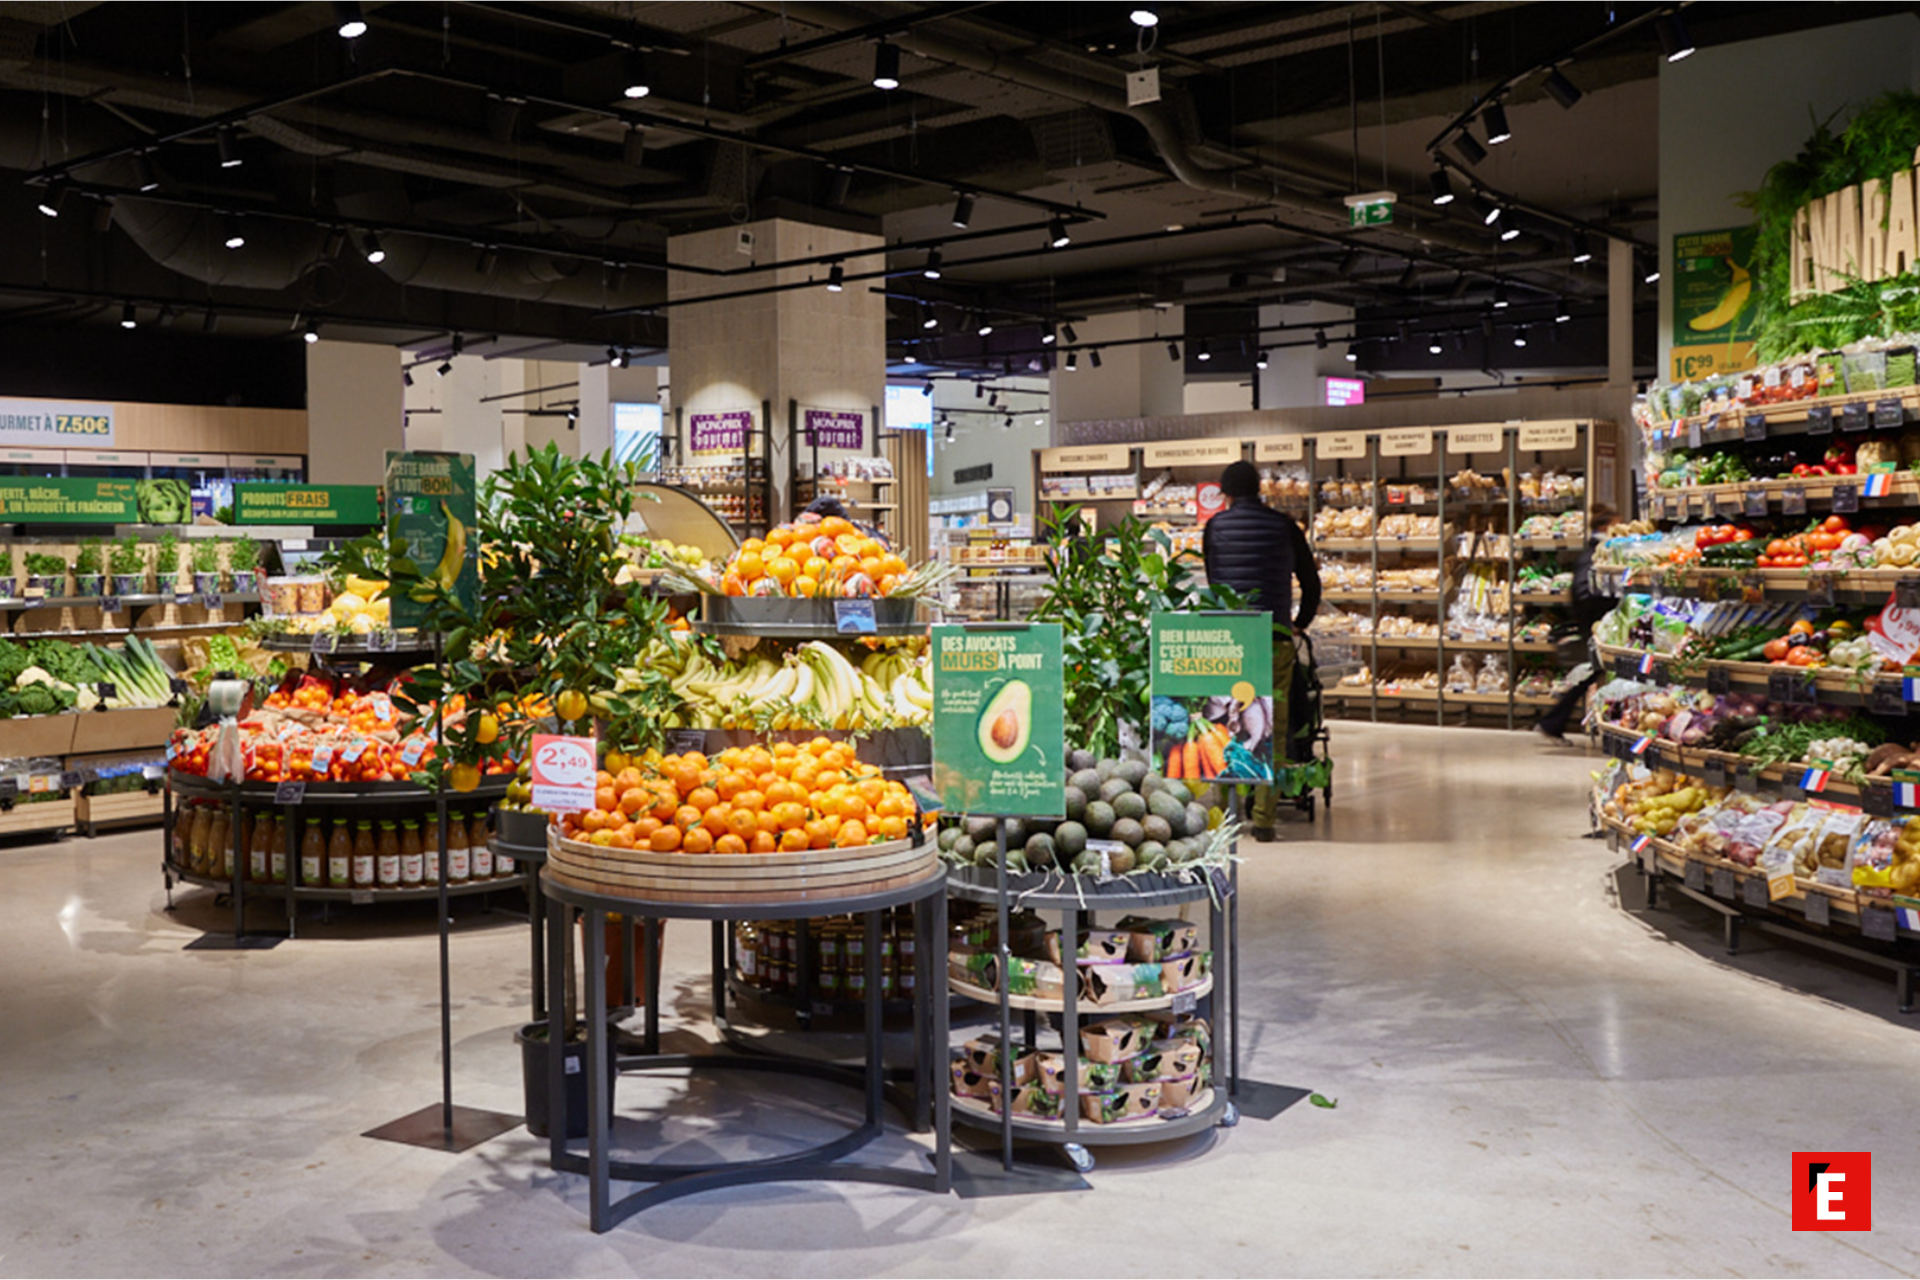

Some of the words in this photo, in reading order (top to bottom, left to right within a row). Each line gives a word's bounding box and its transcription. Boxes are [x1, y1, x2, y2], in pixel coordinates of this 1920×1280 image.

[44, 412, 53, 430] À
[57, 416, 108, 433] 7.50€
[696, 419, 742, 432] MONOPRIX
[812, 417, 856, 430] MONOPRIX
[817, 431, 857, 443] ourmet
[1455, 433, 1494, 443] BAGUETTES
[423, 478, 451, 494] BON
[241, 492, 285, 506] PRODUITS
[287, 493, 327, 506] FRAIS
[941, 636, 964, 652] DES
[965, 636, 1017, 652] AVOCATS
[1160, 629, 1183, 643] BIEN
[1186, 629, 1234, 645] MANGER,
[1160, 645, 1189, 658] C'EST
[1190, 645, 1244, 658] TOUJOURS
[943, 653, 996, 669] MURS
[998, 649, 1007, 670] À
[1008, 653, 1043, 670] POINT
[1160, 660, 1174, 673] DE
[1176, 659, 1240, 673] SAISON
